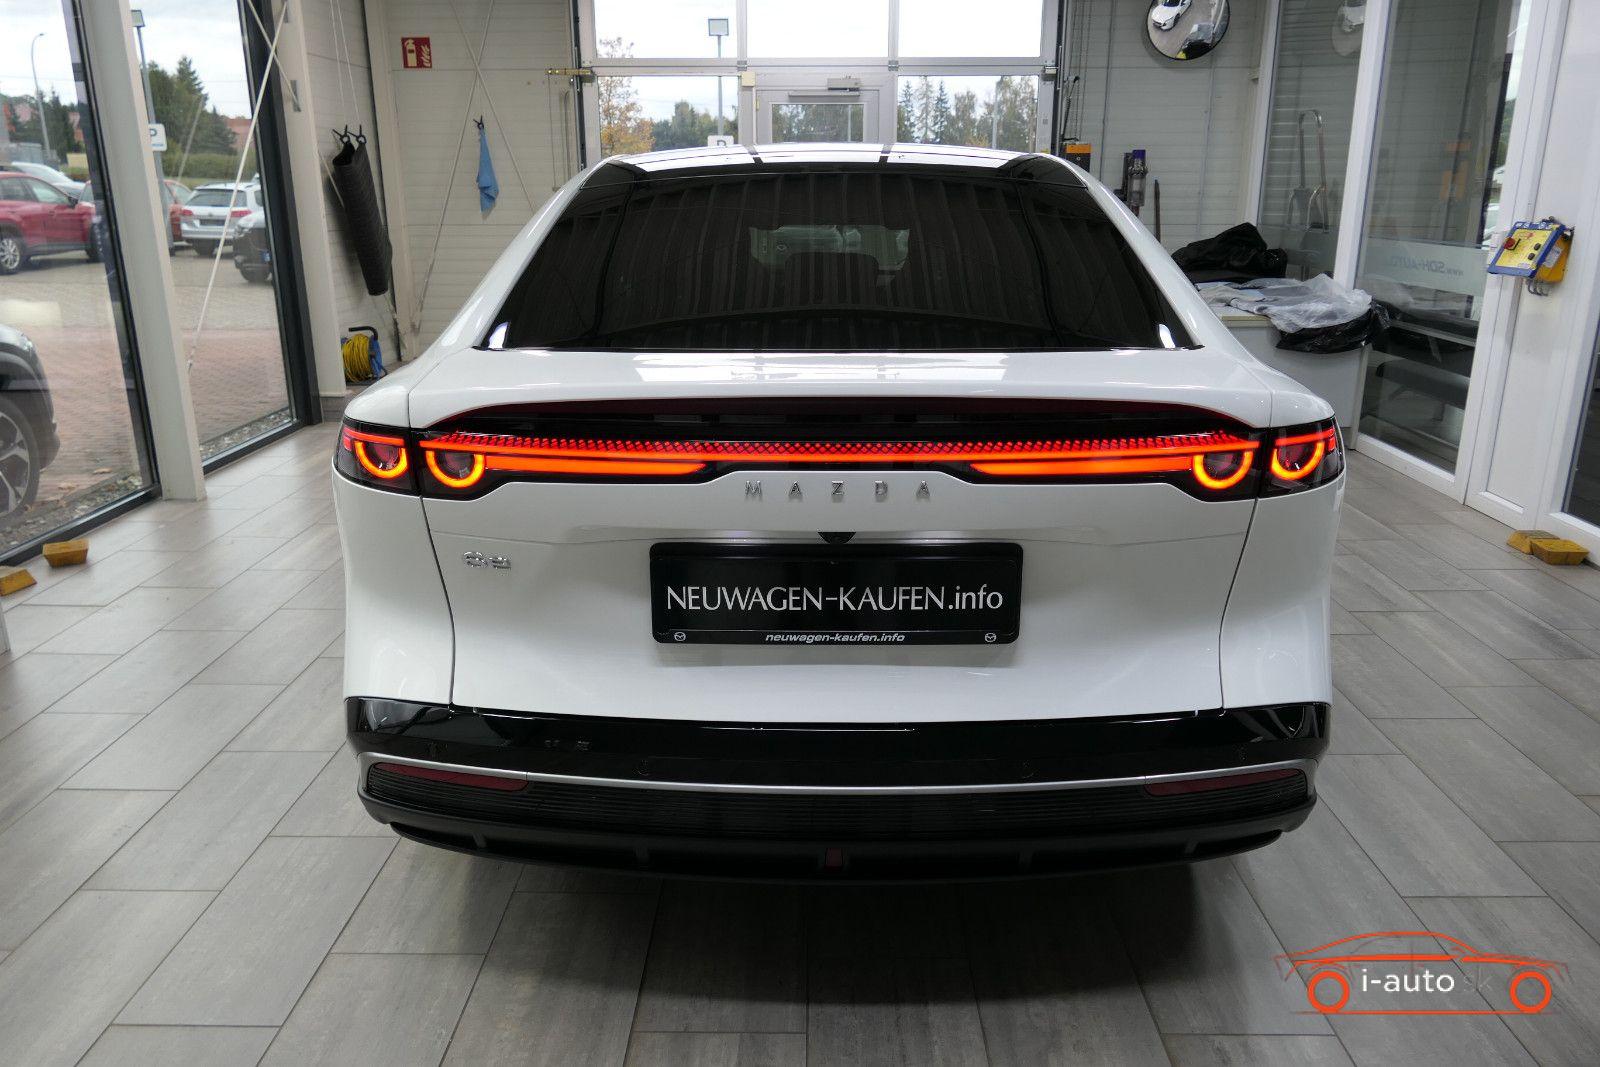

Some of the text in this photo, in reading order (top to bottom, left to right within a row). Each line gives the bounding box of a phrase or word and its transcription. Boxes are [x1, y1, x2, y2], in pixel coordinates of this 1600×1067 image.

[744, 480, 932, 497] MAZDA
[666, 583, 1004, 611] NEUWAGEN-KAUFEN.info
[765, 633, 906, 643] neuwagen-kaufen.info
